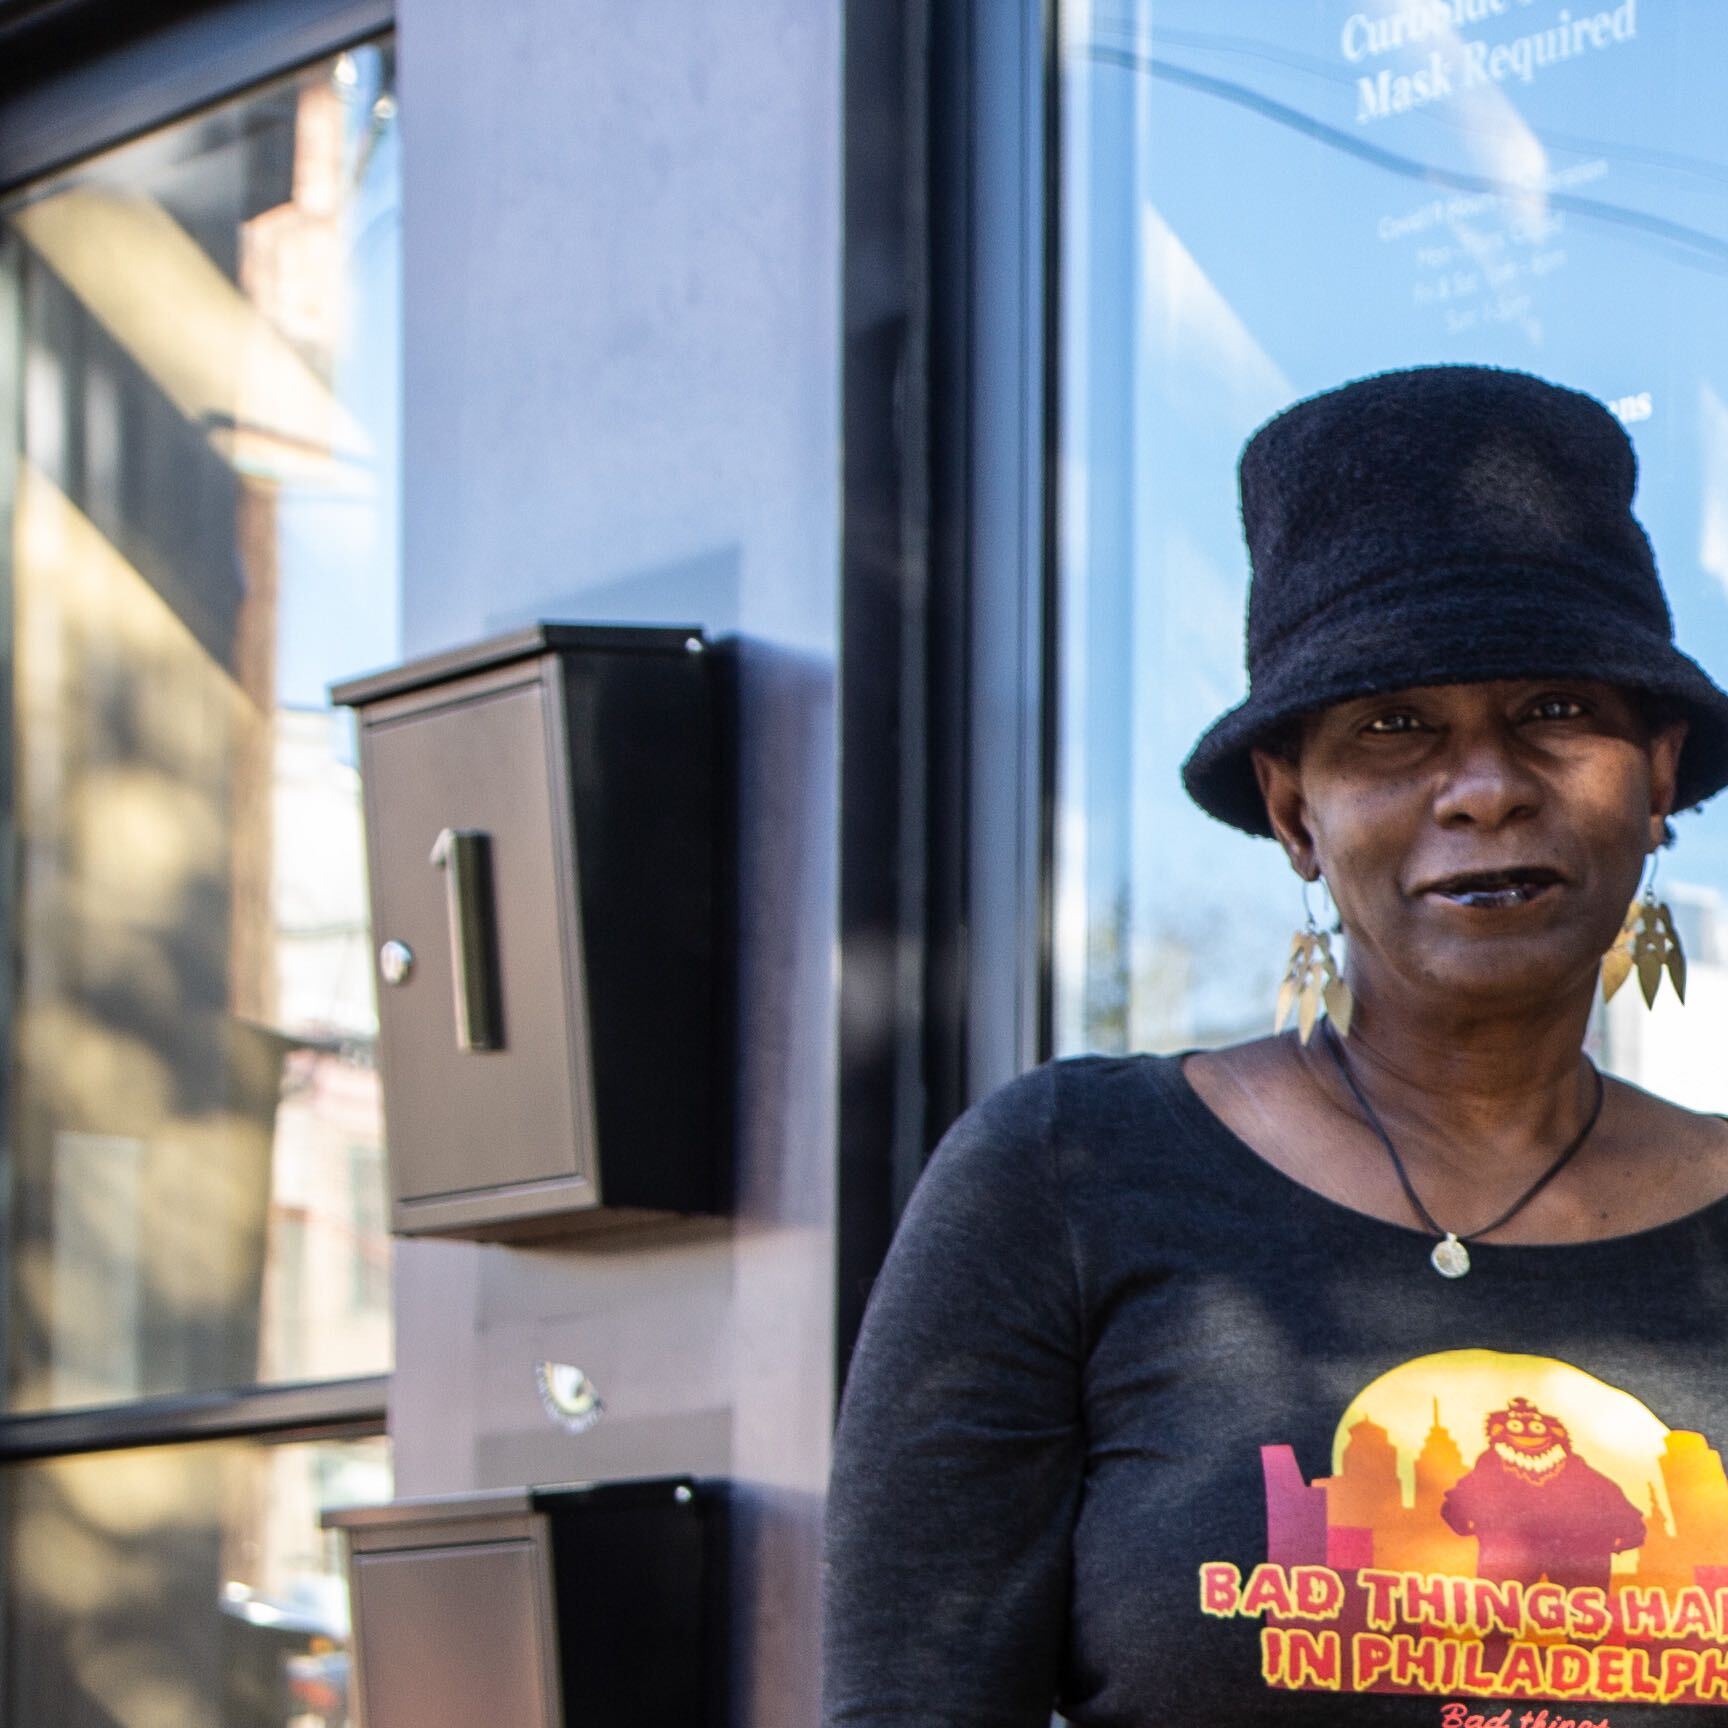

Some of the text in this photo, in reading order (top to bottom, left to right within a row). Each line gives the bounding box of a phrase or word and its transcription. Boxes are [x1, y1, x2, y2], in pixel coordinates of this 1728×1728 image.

[1355, 0, 1637, 125] Mask Required
[429, 827, 490, 1053] 1
[1198, 1561, 1345, 1620] BAD
[1358, 1568, 1611, 1640] THINGS
[1260, 1626, 1341, 1691] IN
